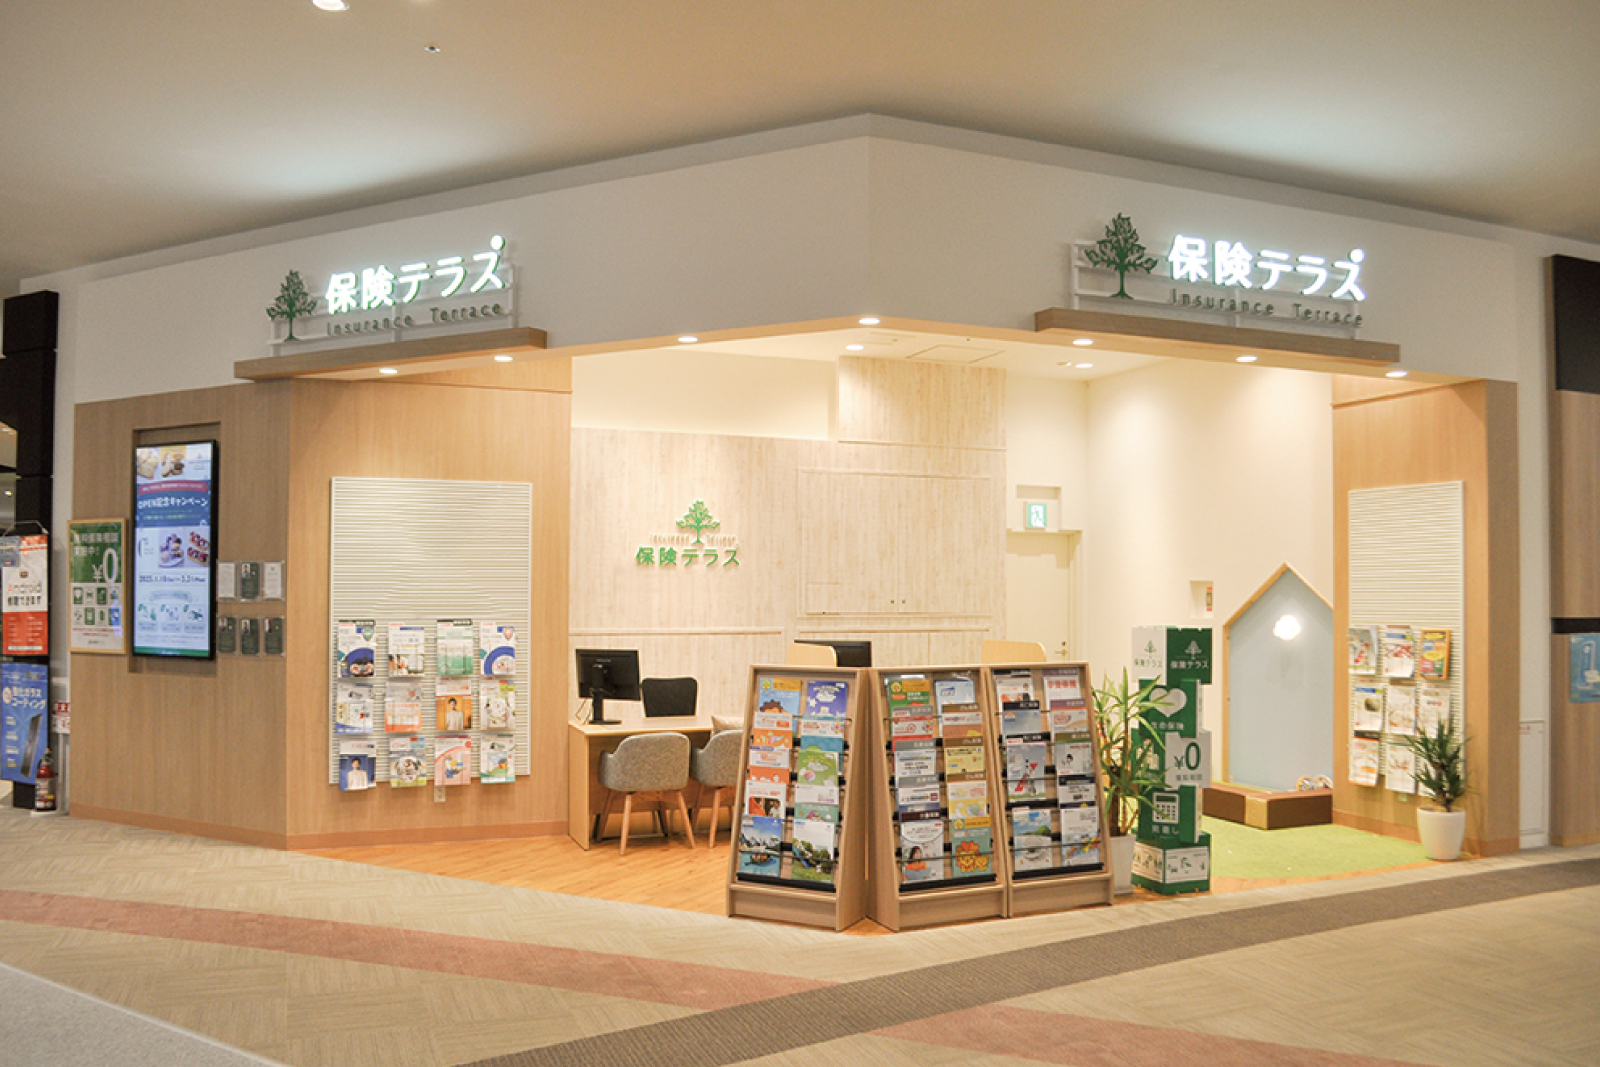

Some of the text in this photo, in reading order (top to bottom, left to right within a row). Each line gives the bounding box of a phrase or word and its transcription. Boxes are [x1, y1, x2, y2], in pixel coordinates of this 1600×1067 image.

[325, 234, 506, 316] 保険テラス
[1166, 234, 1367, 303] 保険テラス
[327, 301, 504, 336] Insurance Terrace
[1171, 288, 1364, 327] Insurance Terrace
[635, 543, 740, 567] 保険テラス
